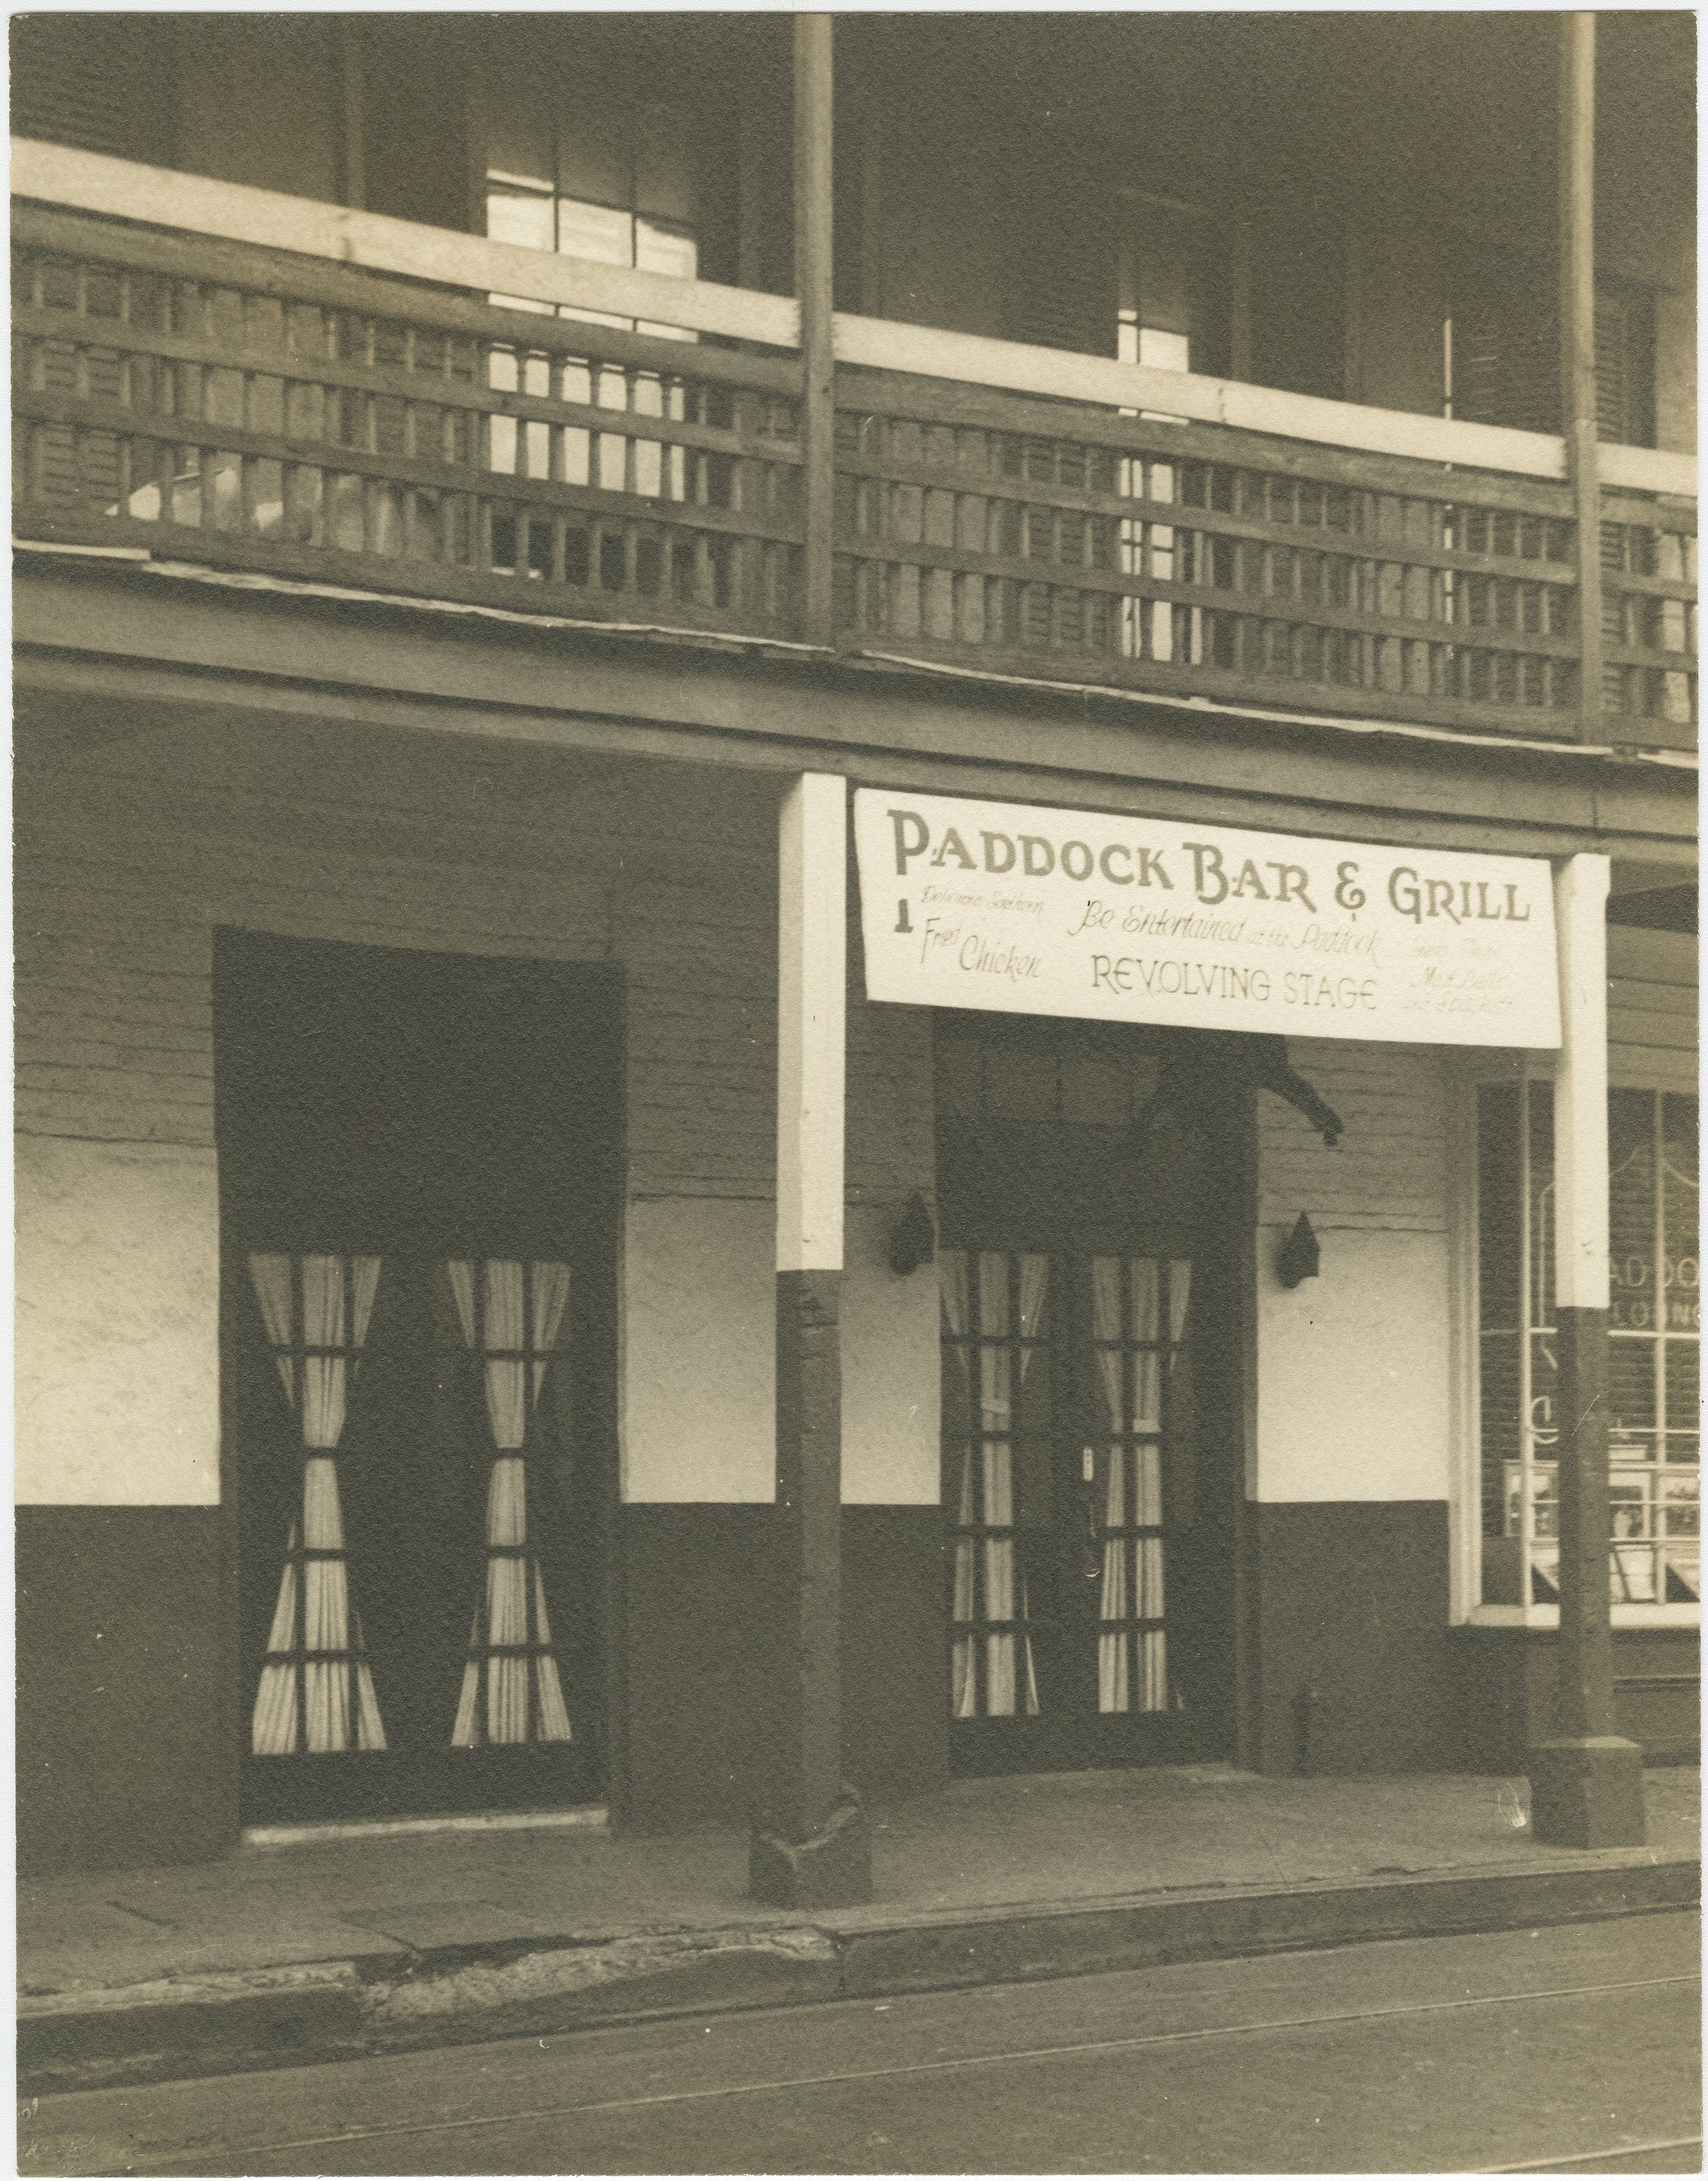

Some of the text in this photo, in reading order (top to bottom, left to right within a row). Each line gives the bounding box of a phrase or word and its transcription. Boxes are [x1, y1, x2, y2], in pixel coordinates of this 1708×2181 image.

[886, 808, 1532, 925] PADDOCK BAR & GRILL
[959, 934, 1042, 983] Chicken
[1067, 900, 1115, 936] Be
[1122, 904, 1248, 942] Entertained
[1291, 923, 1383, 969] Paddock
[1090, 953, 1272, 1002] REVOLVING
[1284, 971, 1378, 1010] STAGE
